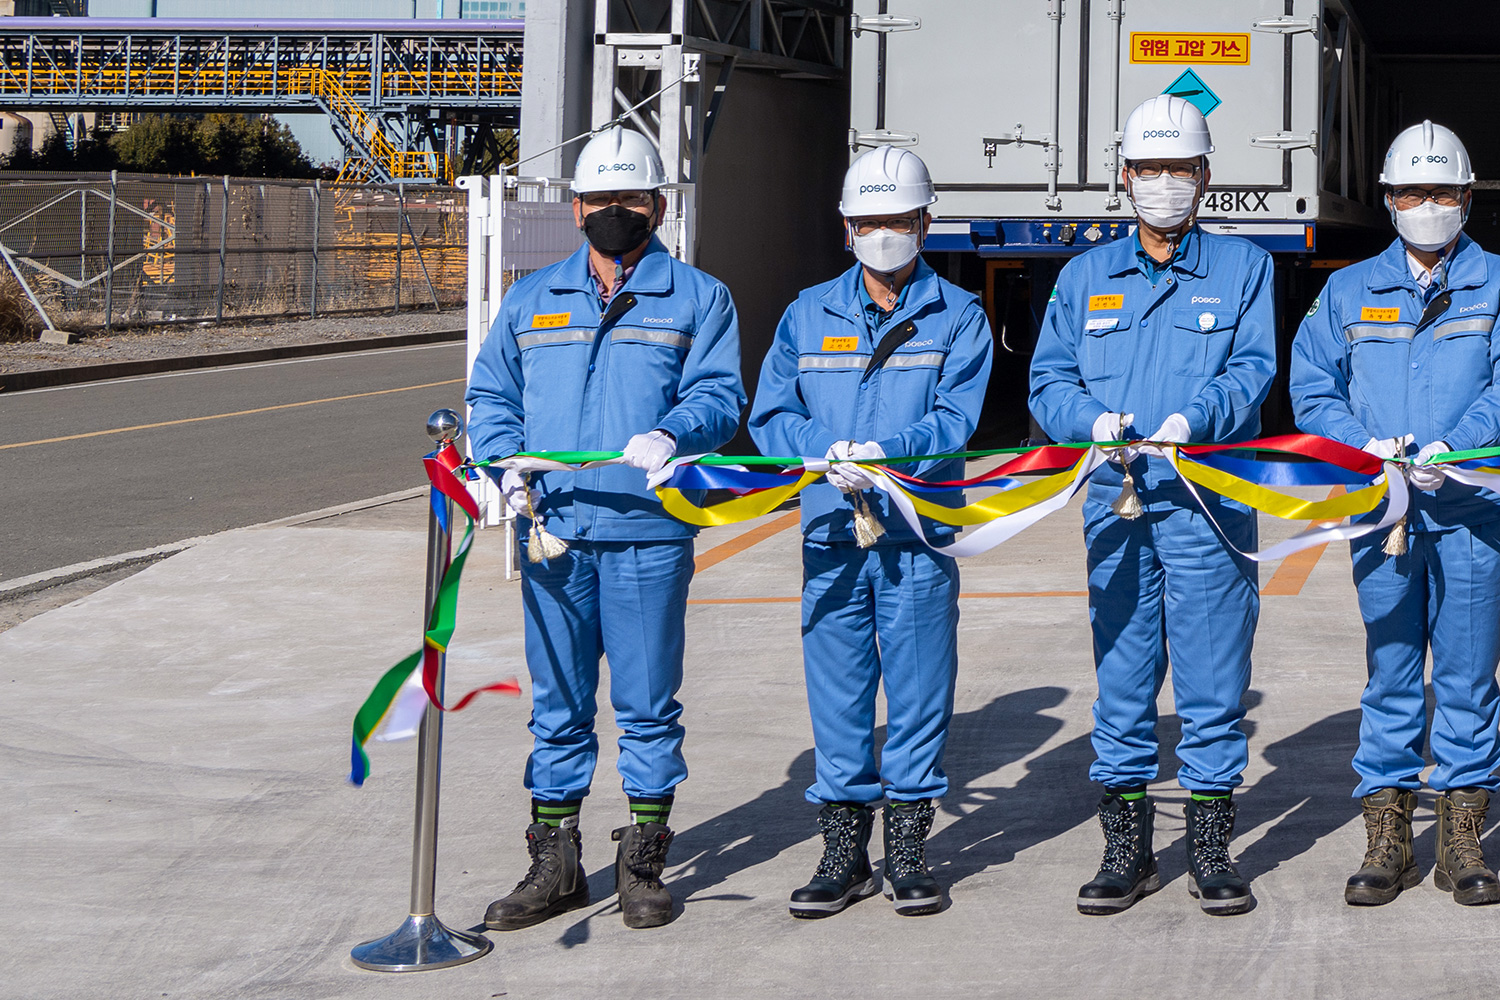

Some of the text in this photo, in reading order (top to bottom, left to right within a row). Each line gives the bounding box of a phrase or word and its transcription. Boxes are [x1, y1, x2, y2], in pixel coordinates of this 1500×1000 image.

[1139, 39, 1241, 57] 위험 고압 가스
[1143, 129, 1180, 141] posco
[859, 183, 897, 196] posco
[1205, 191, 1270, 212] 48KX
[1191, 296, 1221, 304] posco
[1459, 301, 1488, 314] posco
[642, 316, 674, 324] posco
[904, 338, 934, 349] posco
